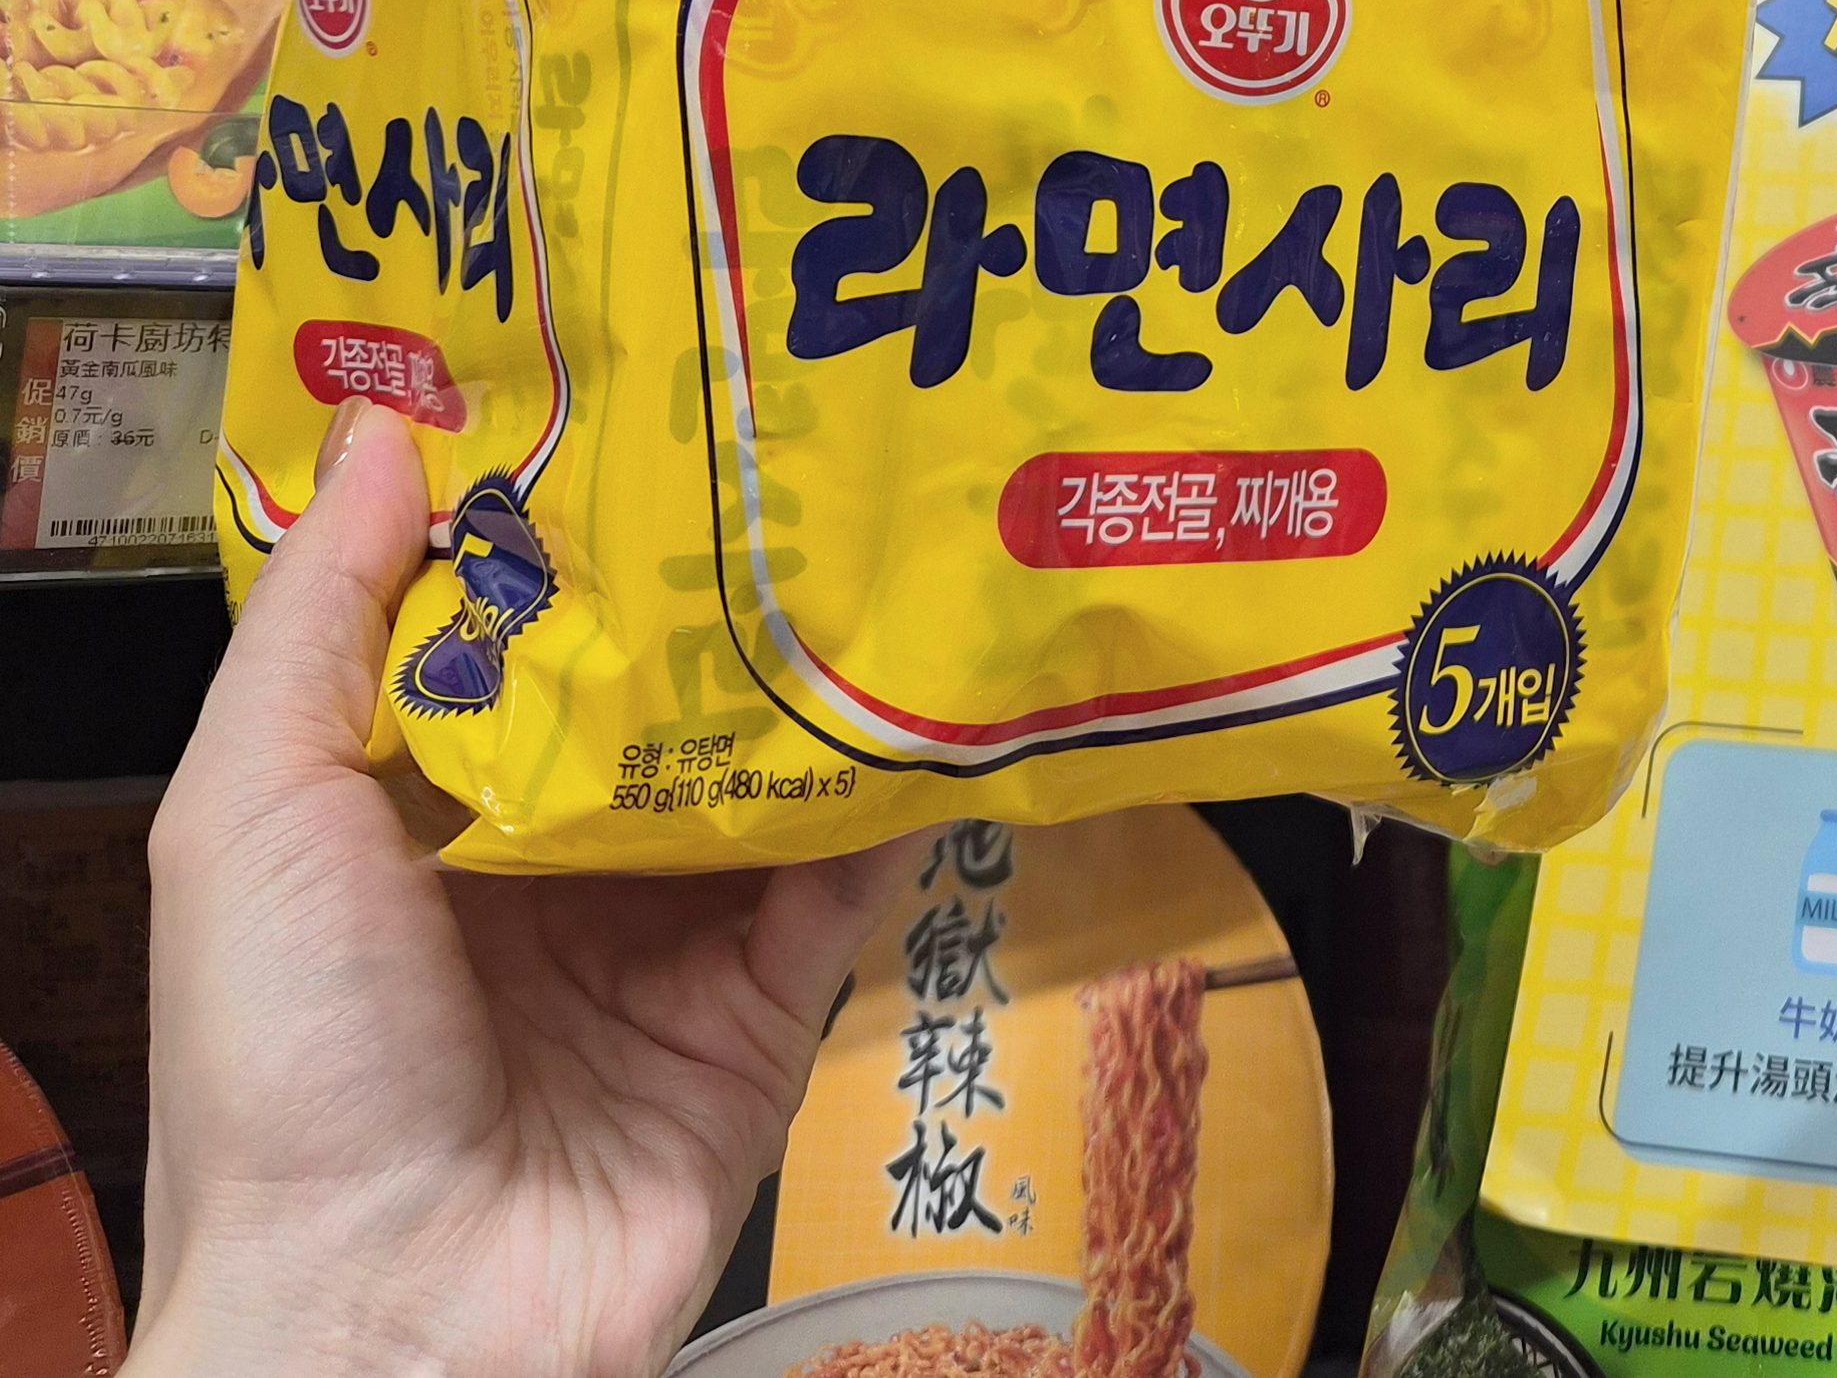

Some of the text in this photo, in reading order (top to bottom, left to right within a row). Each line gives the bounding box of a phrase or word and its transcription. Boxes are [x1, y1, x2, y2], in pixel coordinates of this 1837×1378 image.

[1199, 0, 1311, 58] 오뚜기
[785, 133, 1581, 394] 라면사리
[55, 385, 93, 405] 47g
[59, 358, 178, 379] 黃金南瓜風味
[10, 378, 53, 484] 促銷價
[54, 406, 124, 428] 0.7元/g
[1232, 467, 1341, 539] 찌개용
[1417, 623, 1557, 736] 5개입
[677, 731, 737, 772] 유탕면
[609, 782, 650, 812] 550
[884, 817, 1014, 1239] 地獄辣椒
[1006, 1175, 1038, 1238] 風味
[1600, 1319, 1701, 1354] Kyushu
[1707, 1325, 1834, 1364] Seaweed
